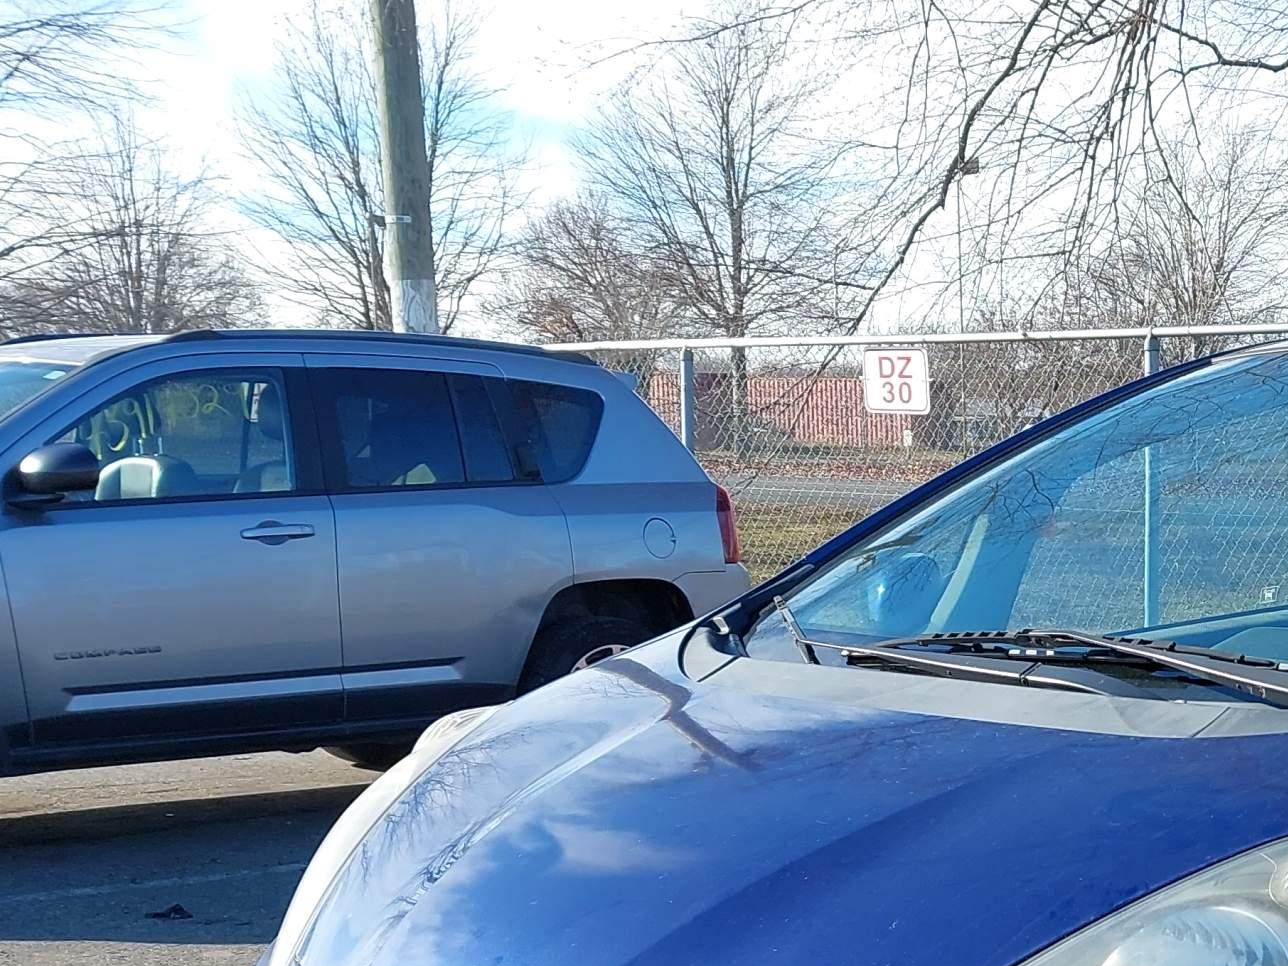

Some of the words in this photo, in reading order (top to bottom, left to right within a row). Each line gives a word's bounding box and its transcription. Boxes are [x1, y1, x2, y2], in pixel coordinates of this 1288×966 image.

[878, 356, 913, 379] DZ
[882, 381, 913, 404] 30
[54, 645, 162, 661] COMPASS
